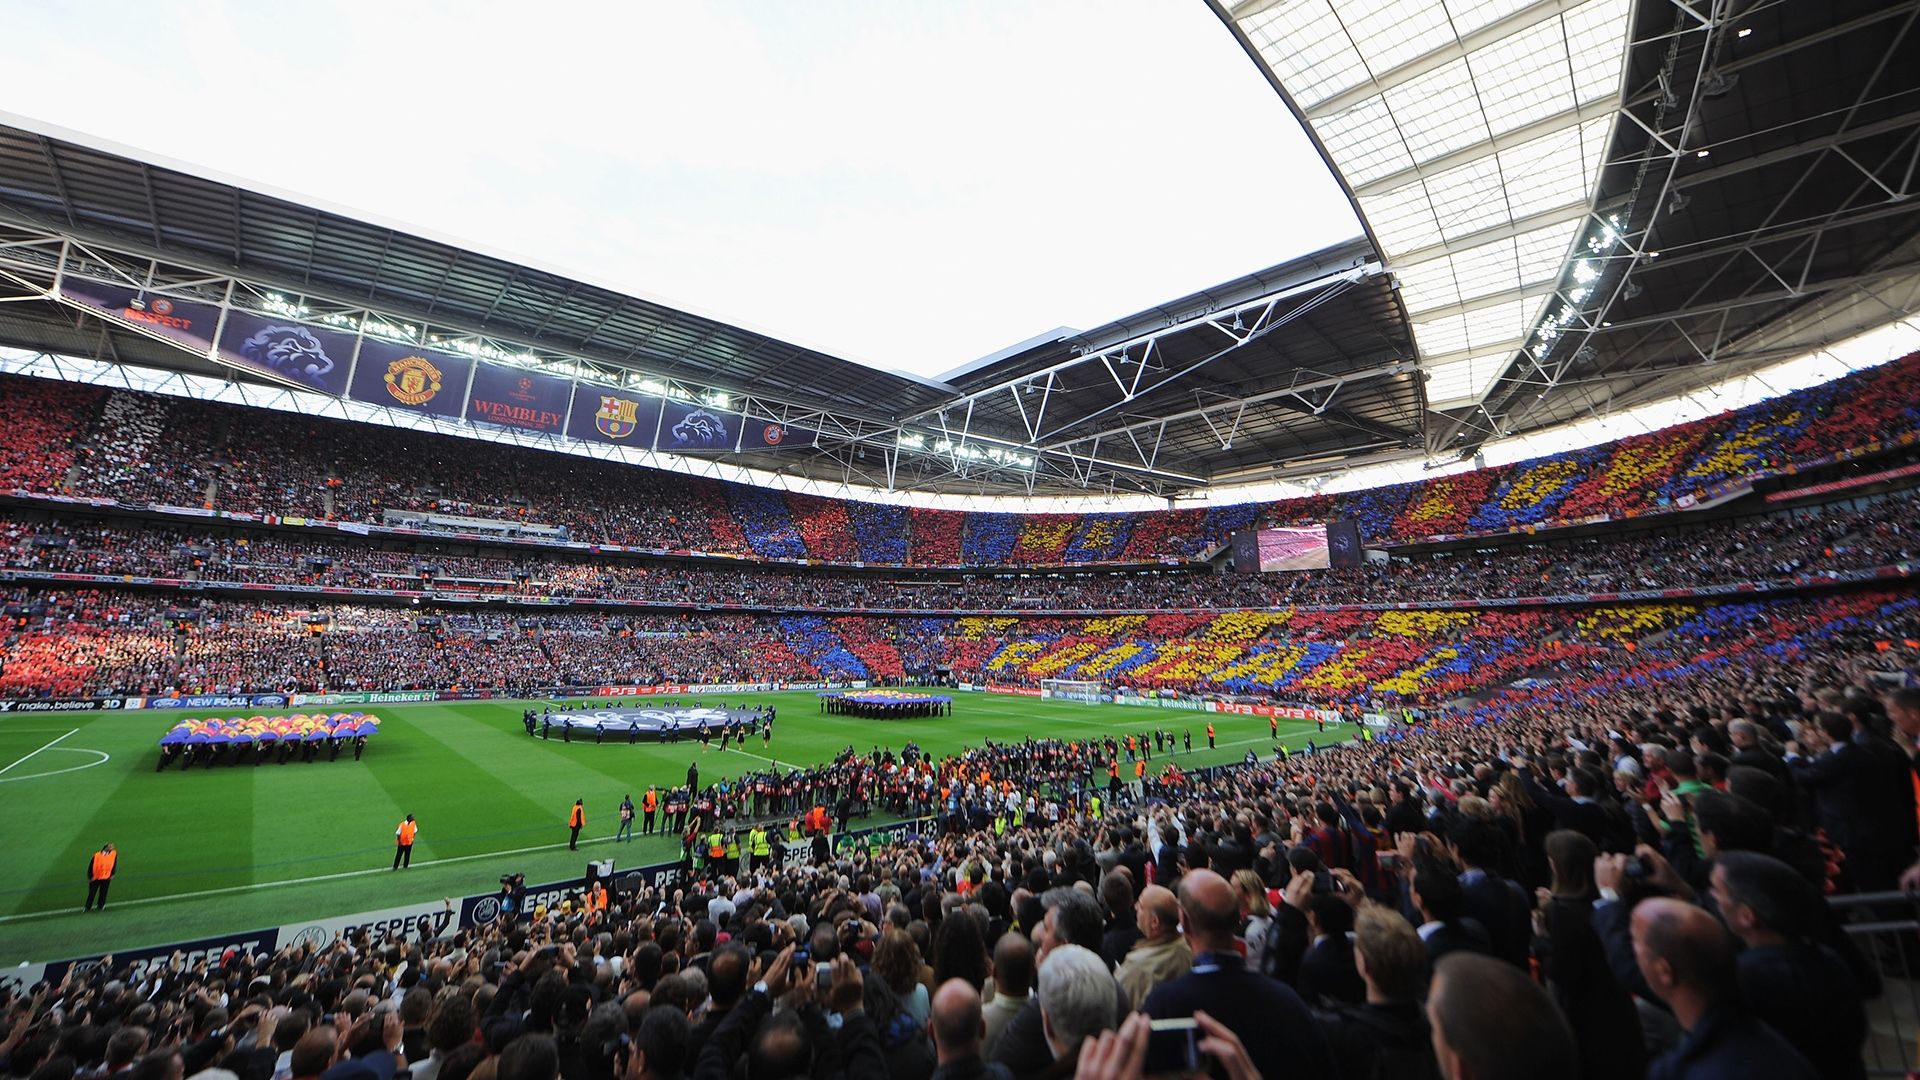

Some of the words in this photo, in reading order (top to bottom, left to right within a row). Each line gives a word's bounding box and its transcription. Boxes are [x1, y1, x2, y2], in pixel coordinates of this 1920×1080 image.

[474, 399, 562, 426] WEMBLEY
[609, 687, 637, 696] PS3
[655, 686, 681, 694] PS3
[187, 698, 213, 706] NEW
[214, 697, 253, 706] FOCU
[369, 693, 421, 703] Heineken
[102, 699, 120, 709] 3D
[1161, 698, 1198, 709] Heineken
[1224, 703, 1253, 714] PS3
[1274, 707, 1305, 719] PS3
